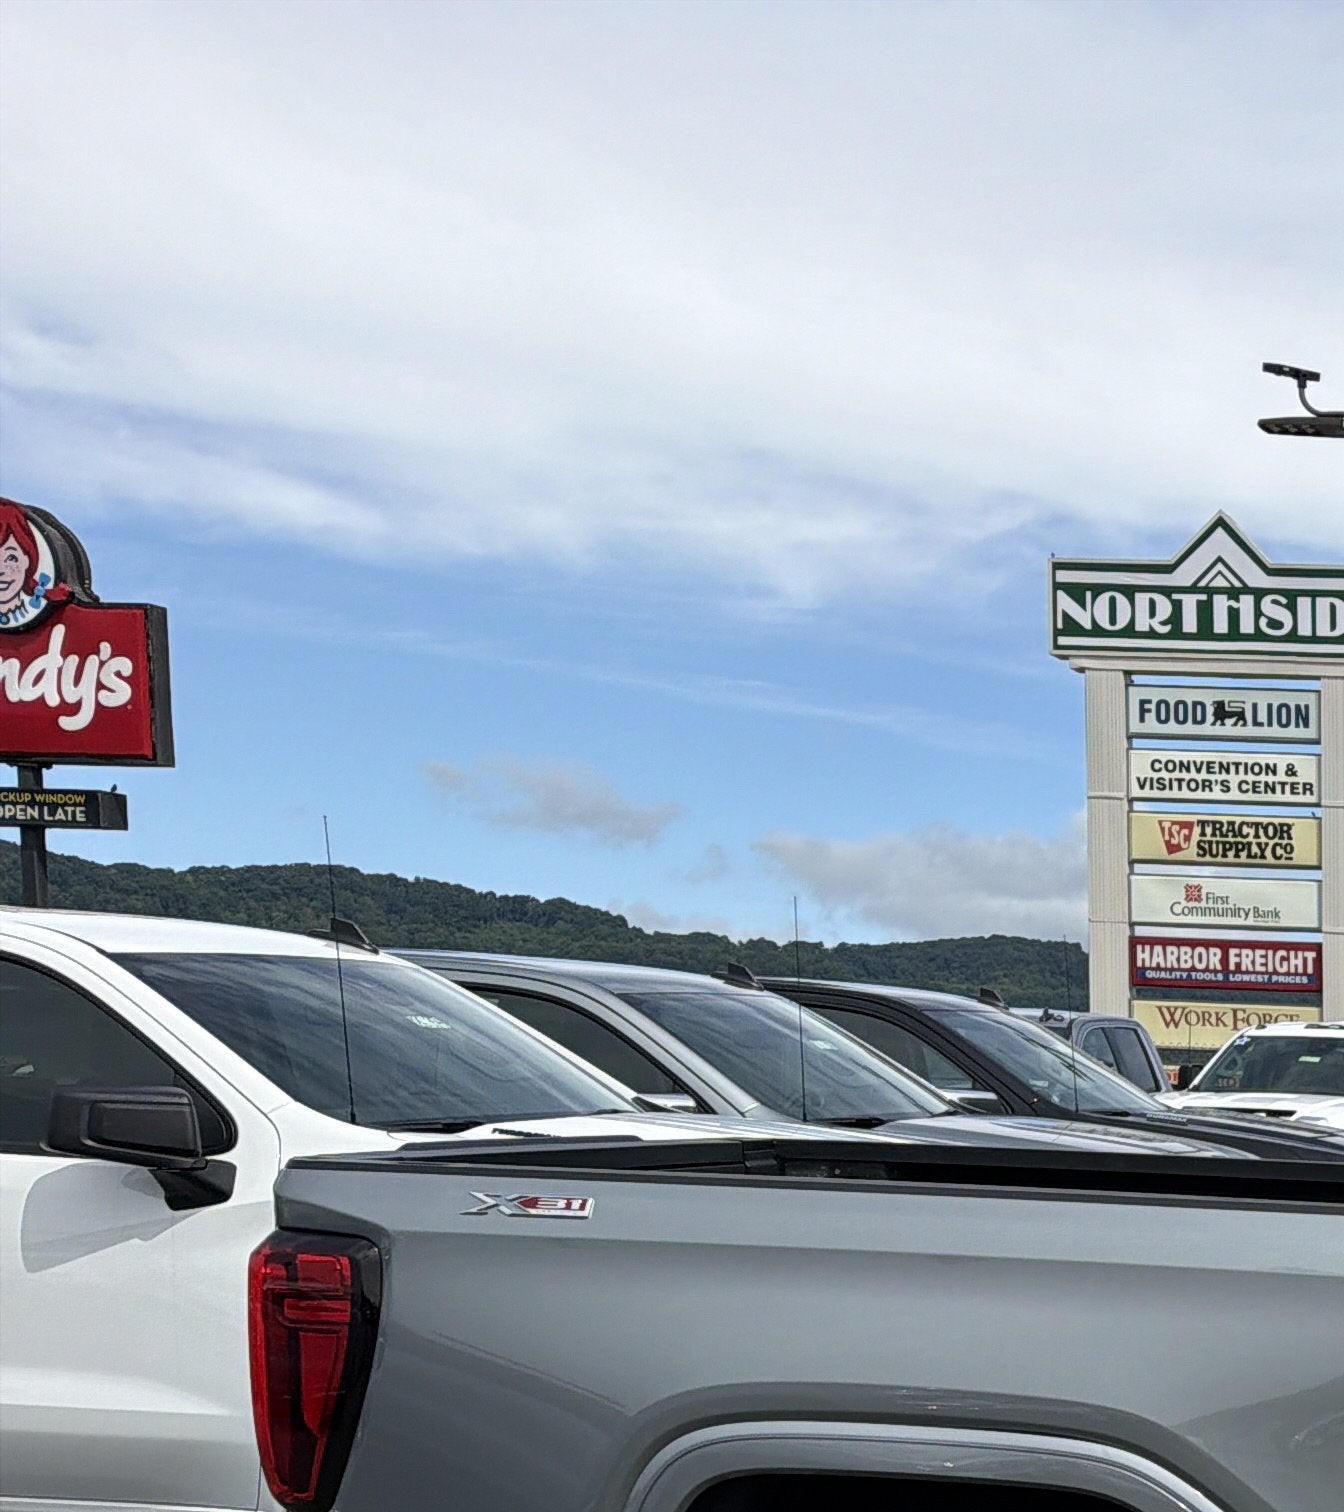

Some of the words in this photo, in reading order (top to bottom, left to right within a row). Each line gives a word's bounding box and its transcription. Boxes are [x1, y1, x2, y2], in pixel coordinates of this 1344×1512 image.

[0, 623, 134, 732] ndy's
[1138, 698, 1207, 726] FOOD
[1251, 702, 1310, 729] LION
[1150, 758, 1278, 777] CONVENTION
[1284, 762, 1299, 778] &
[1136, 776, 1232, 794] VISITOR'S
[1237, 780, 1315, 796] CENTER
[0, 791, 32, 803] CKUP
[34, 792, 86, 806] WINDOW
[43, 805, 87, 822] LATE
[1161, 821, 1191, 849] TSC
[1196, 819, 1294, 841] TRACTOR
[1196, 840, 1269, 861] SUPPLY
[1205, 891, 1231, 906] First
[1169, 901, 1252, 921] Community
[1252, 906, 1281, 920] Bank
[1136, 944, 1223, 970] HARBOR
[1228, 948, 1317, 975] FREIGHT
[1145, 970, 1189, 980] QUALITY
[1190, 972, 1224, 981] TOOLS
[1229, 974, 1270, 983] LOWEST
[1271, 975, 1308, 984] PRICES
[1155, 1005, 1228, 1030] WORK
